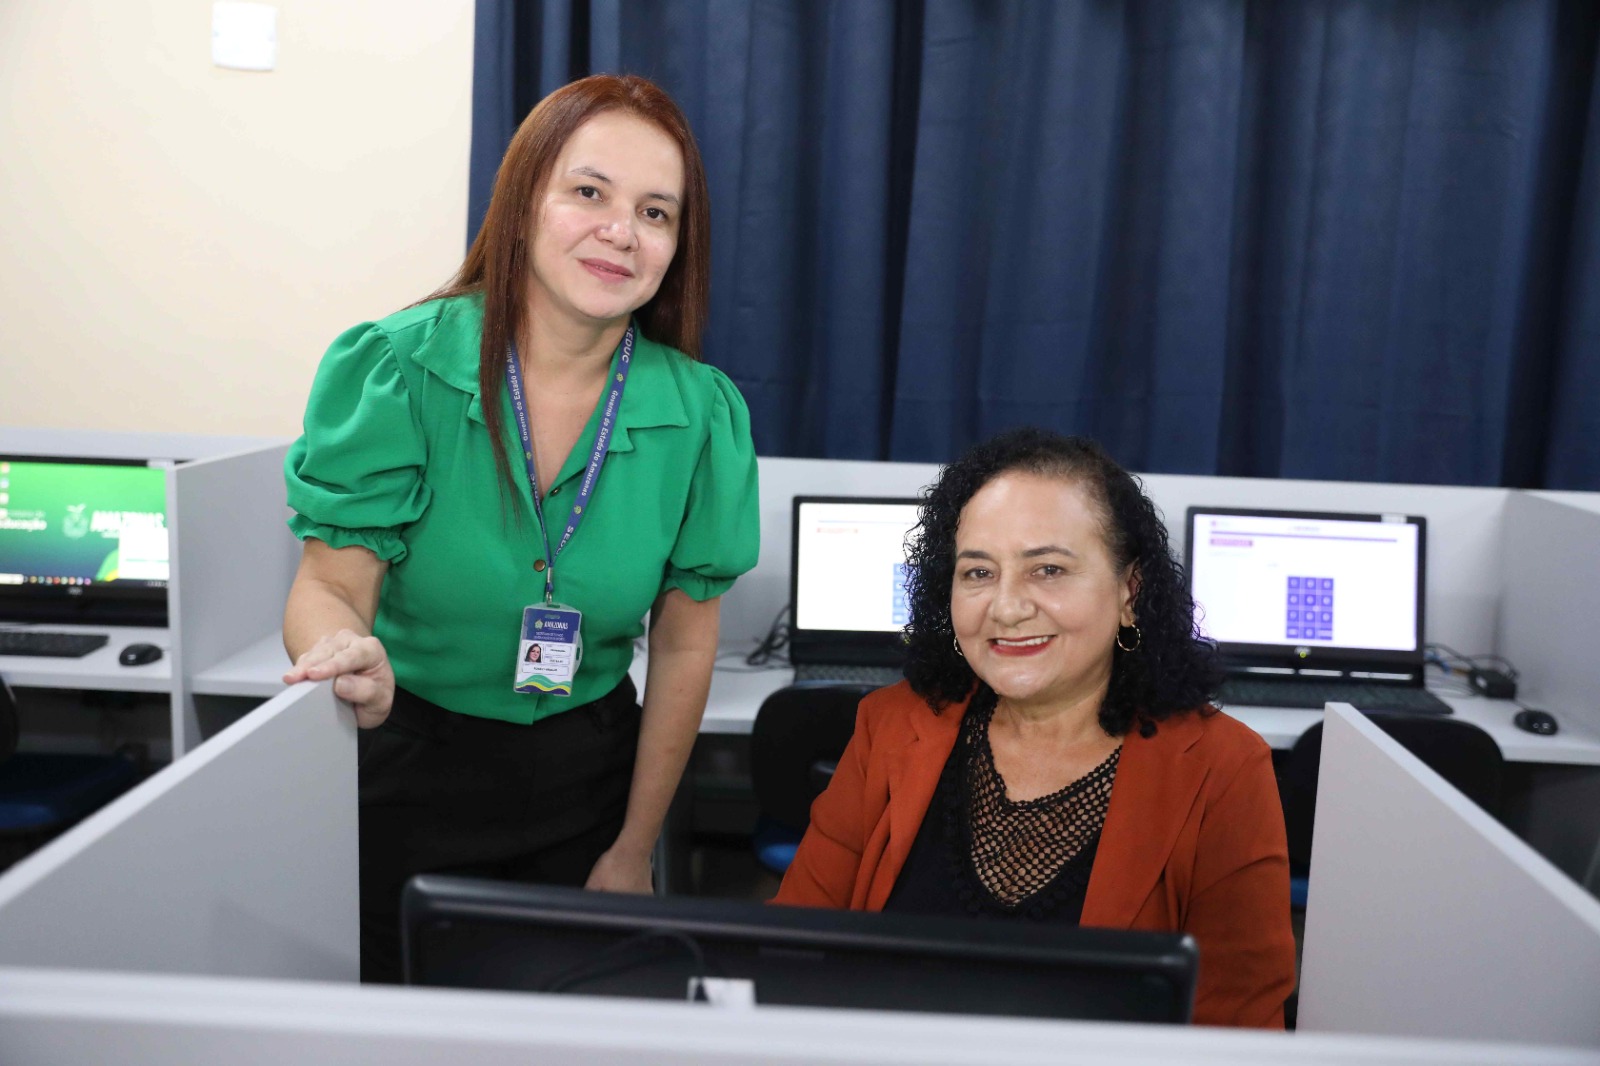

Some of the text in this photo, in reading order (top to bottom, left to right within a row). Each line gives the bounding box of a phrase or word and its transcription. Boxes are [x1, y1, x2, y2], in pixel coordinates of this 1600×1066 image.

[622, 327, 634, 364] SEDUC
[511, 375, 521, 401] Estado
[606, 390, 619, 417] Governo
[519, 412, 528, 441] Governo
[597, 427, 609, 451] Estado
[594, 451, 601, 461] do
[581, 460, 598, 497] Amazonas
